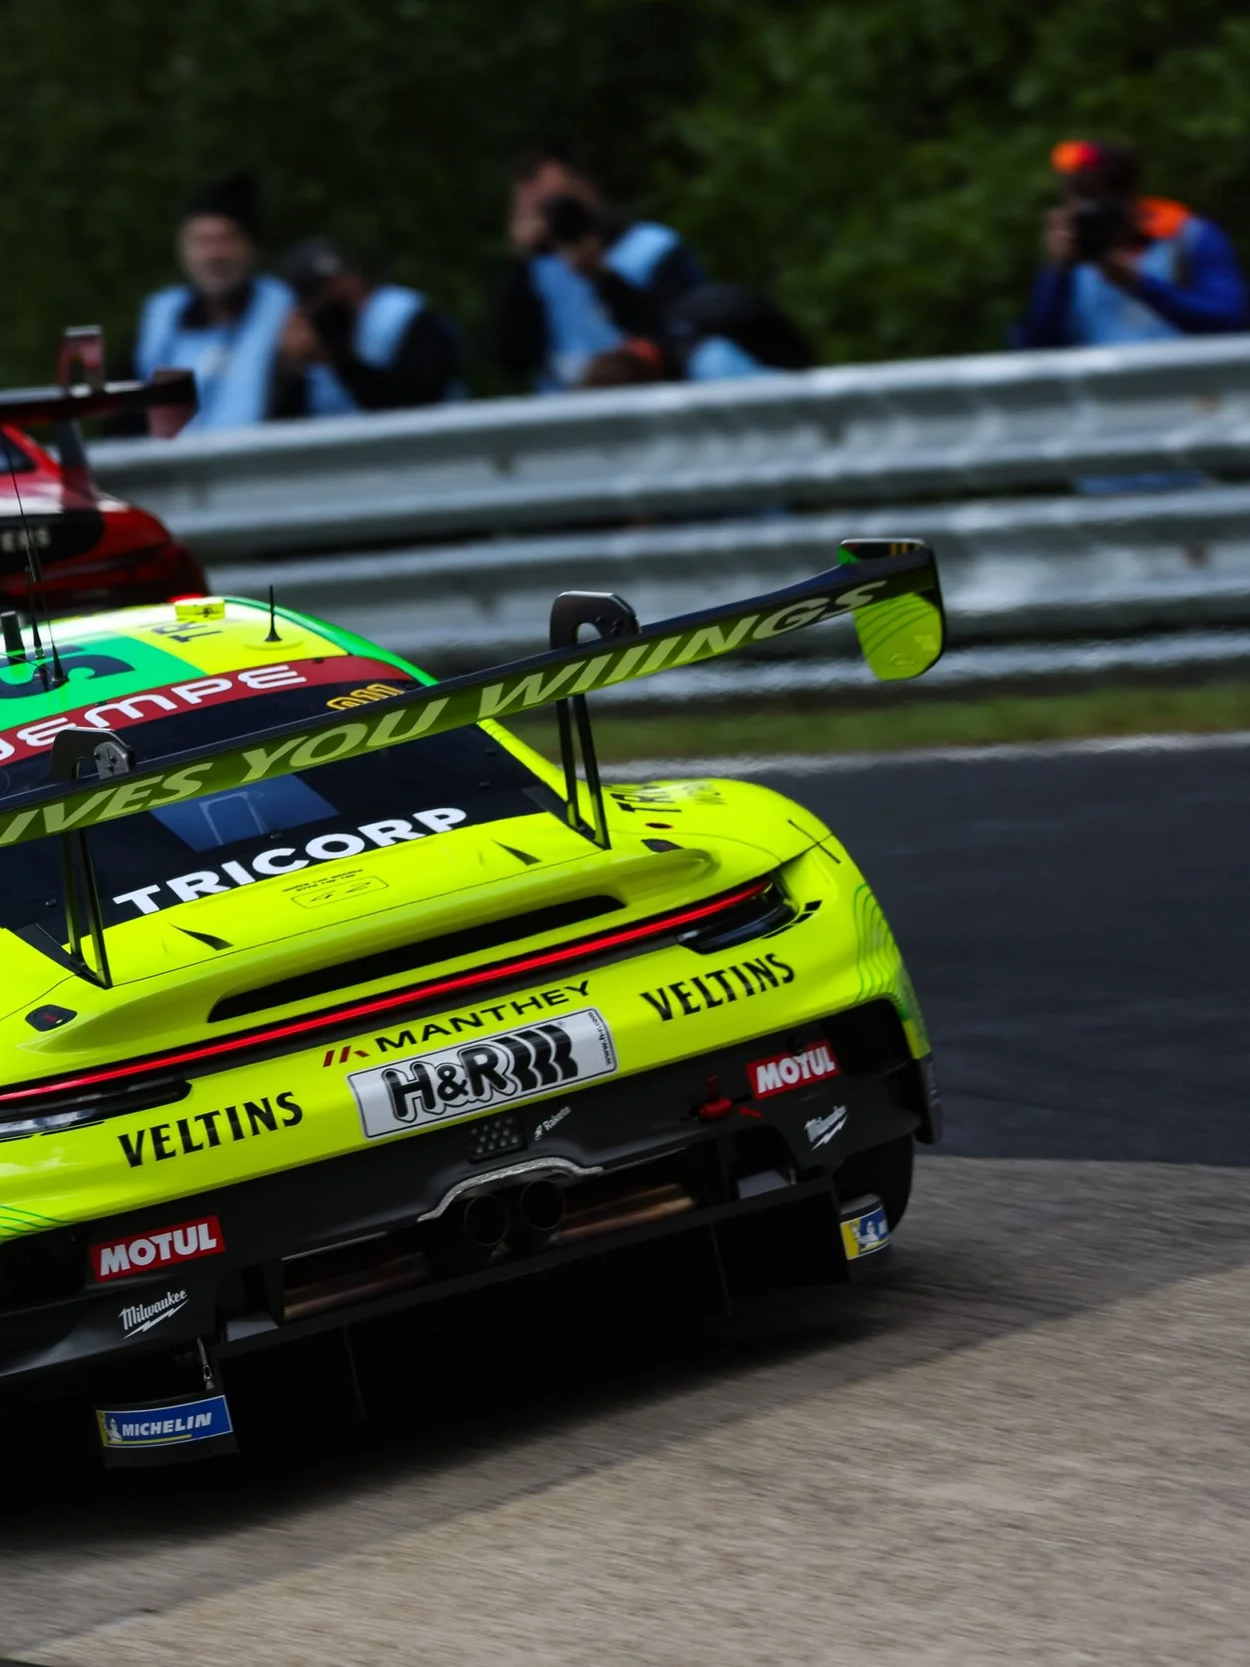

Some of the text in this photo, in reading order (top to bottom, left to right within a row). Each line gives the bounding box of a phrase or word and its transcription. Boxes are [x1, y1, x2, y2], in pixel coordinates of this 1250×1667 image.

[241, 697, 450, 784] YOU
[478, 580, 888, 718] WIIINGS
[113, 808, 467, 915] TRICORP
[375, 981, 589, 1052] MANTHEY
[639, 953, 795, 1022] VELTINS
[382, 1044, 517, 1122] H&R
[756, 1046, 835, 1094] MOTUL
[117, 1091, 303, 1168] VELTINS
[100, 1222, 217, 1276] MOTUL
[118, 1288, 188, 1330] Milwaukee
[122, 1412, 213, 1436] MICHELIN
